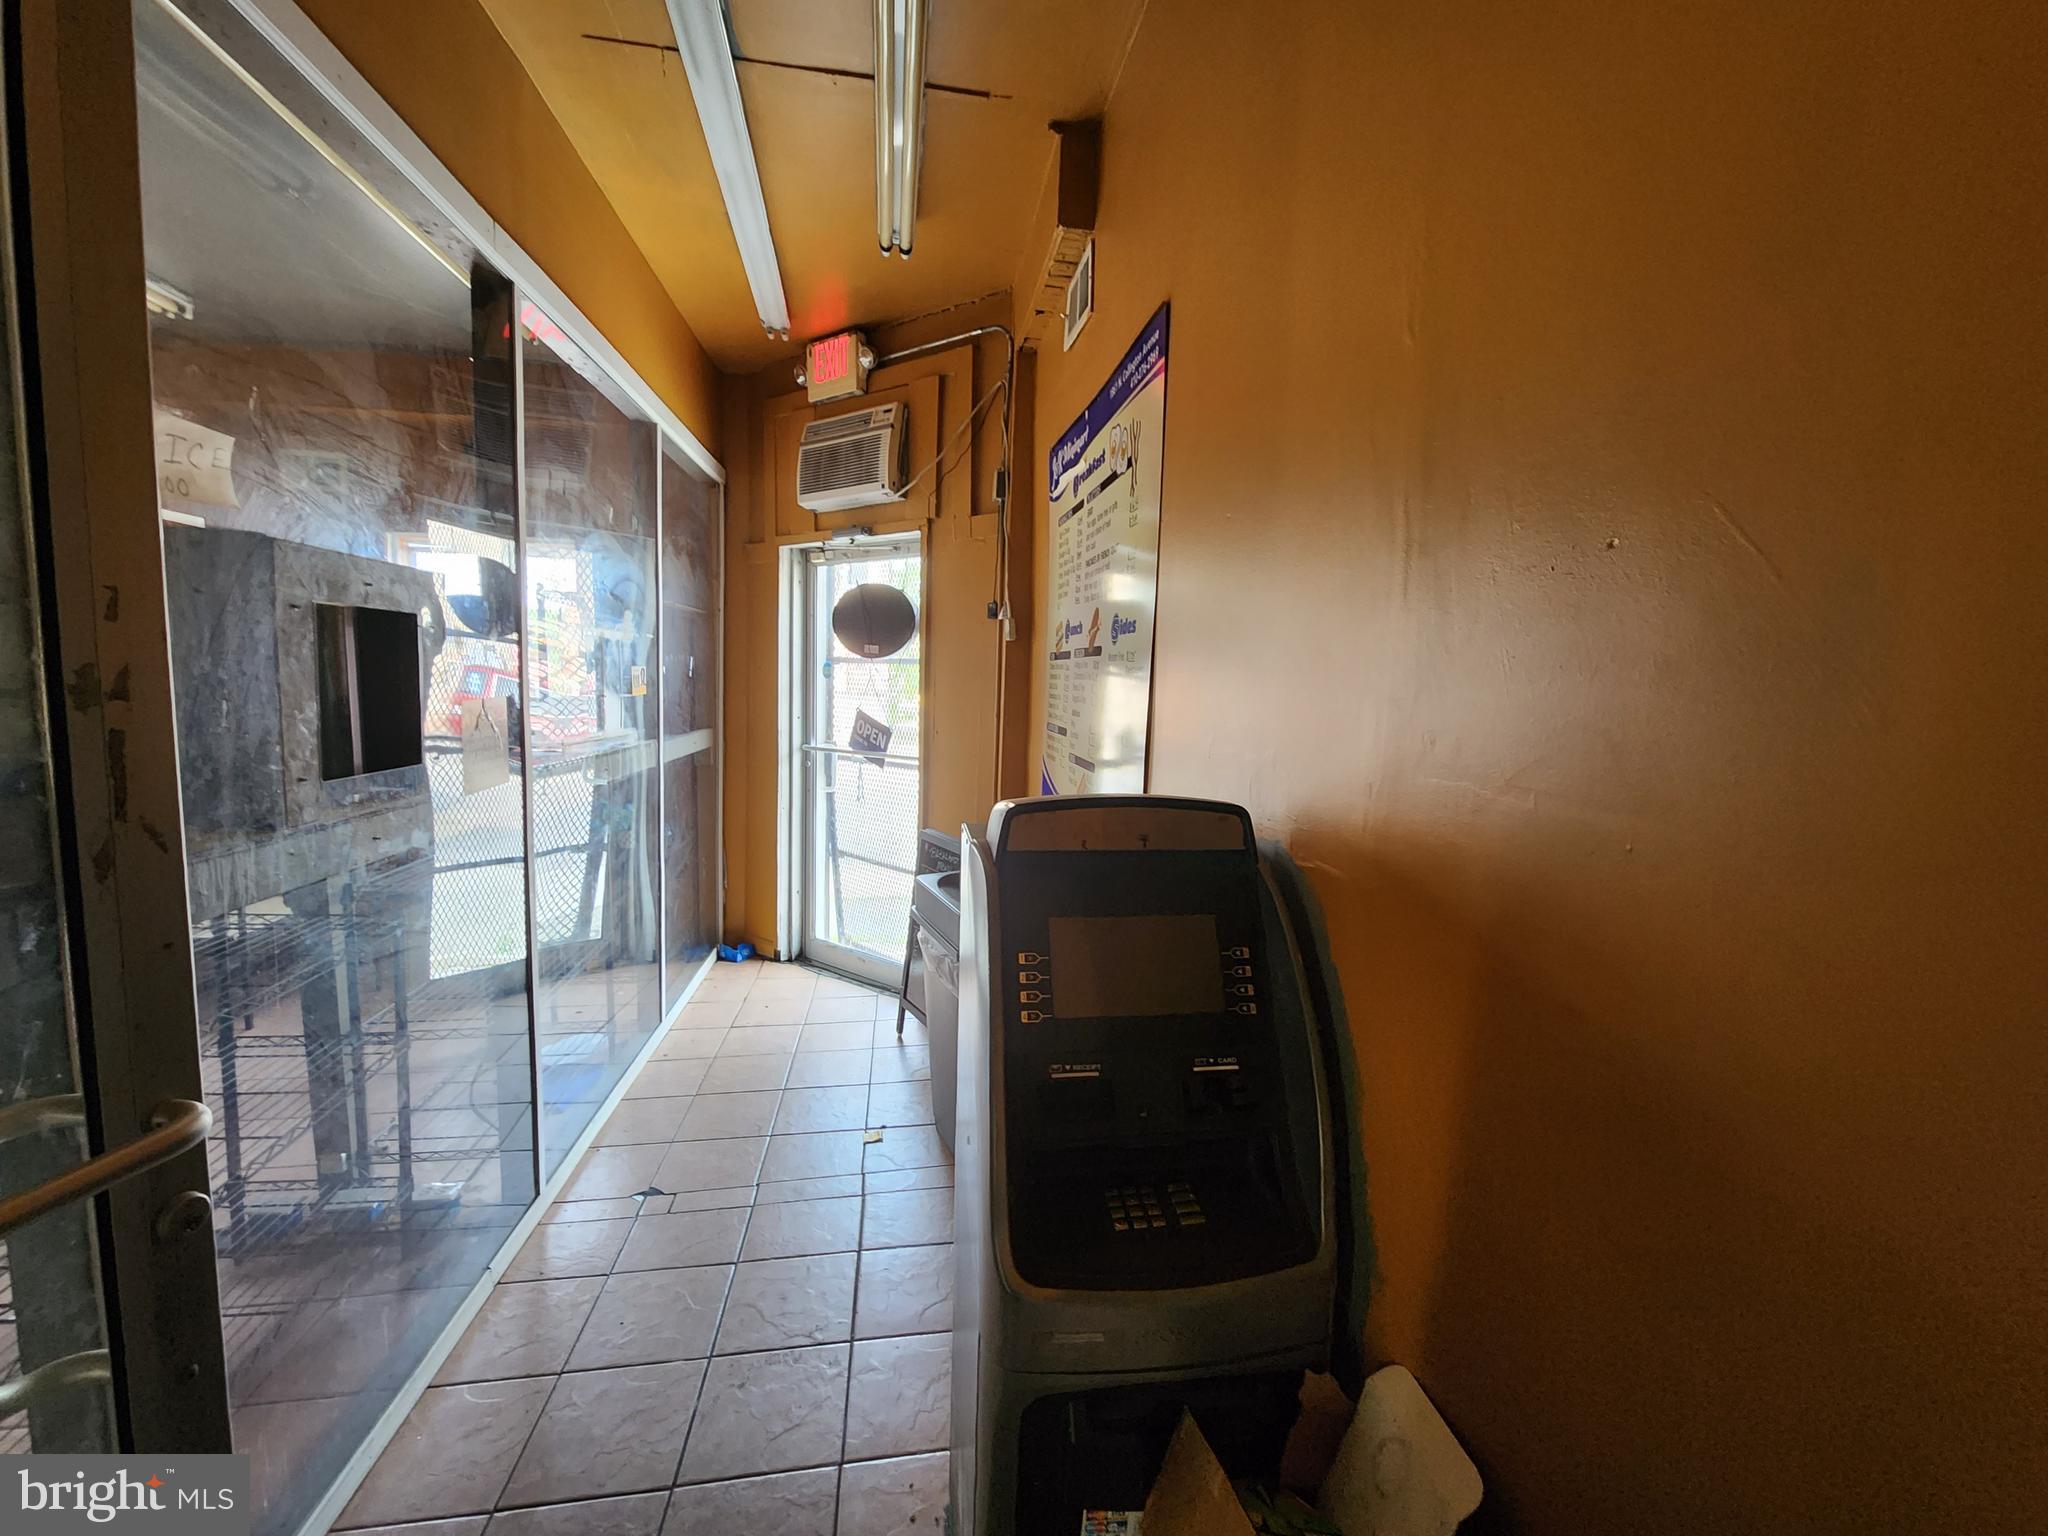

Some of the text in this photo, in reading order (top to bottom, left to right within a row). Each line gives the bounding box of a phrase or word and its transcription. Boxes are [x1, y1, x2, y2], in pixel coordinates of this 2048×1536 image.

[814, 335, 850, 384] EXIT
[163, 433, 232, 471] ICE
[1072, 448, 1106, 499] Breakfast
[1111, 614, 1137, 643] Sides
[856, 718, 888, 750] OPEN
[1217, 1056, 1238, 1064] CARD
